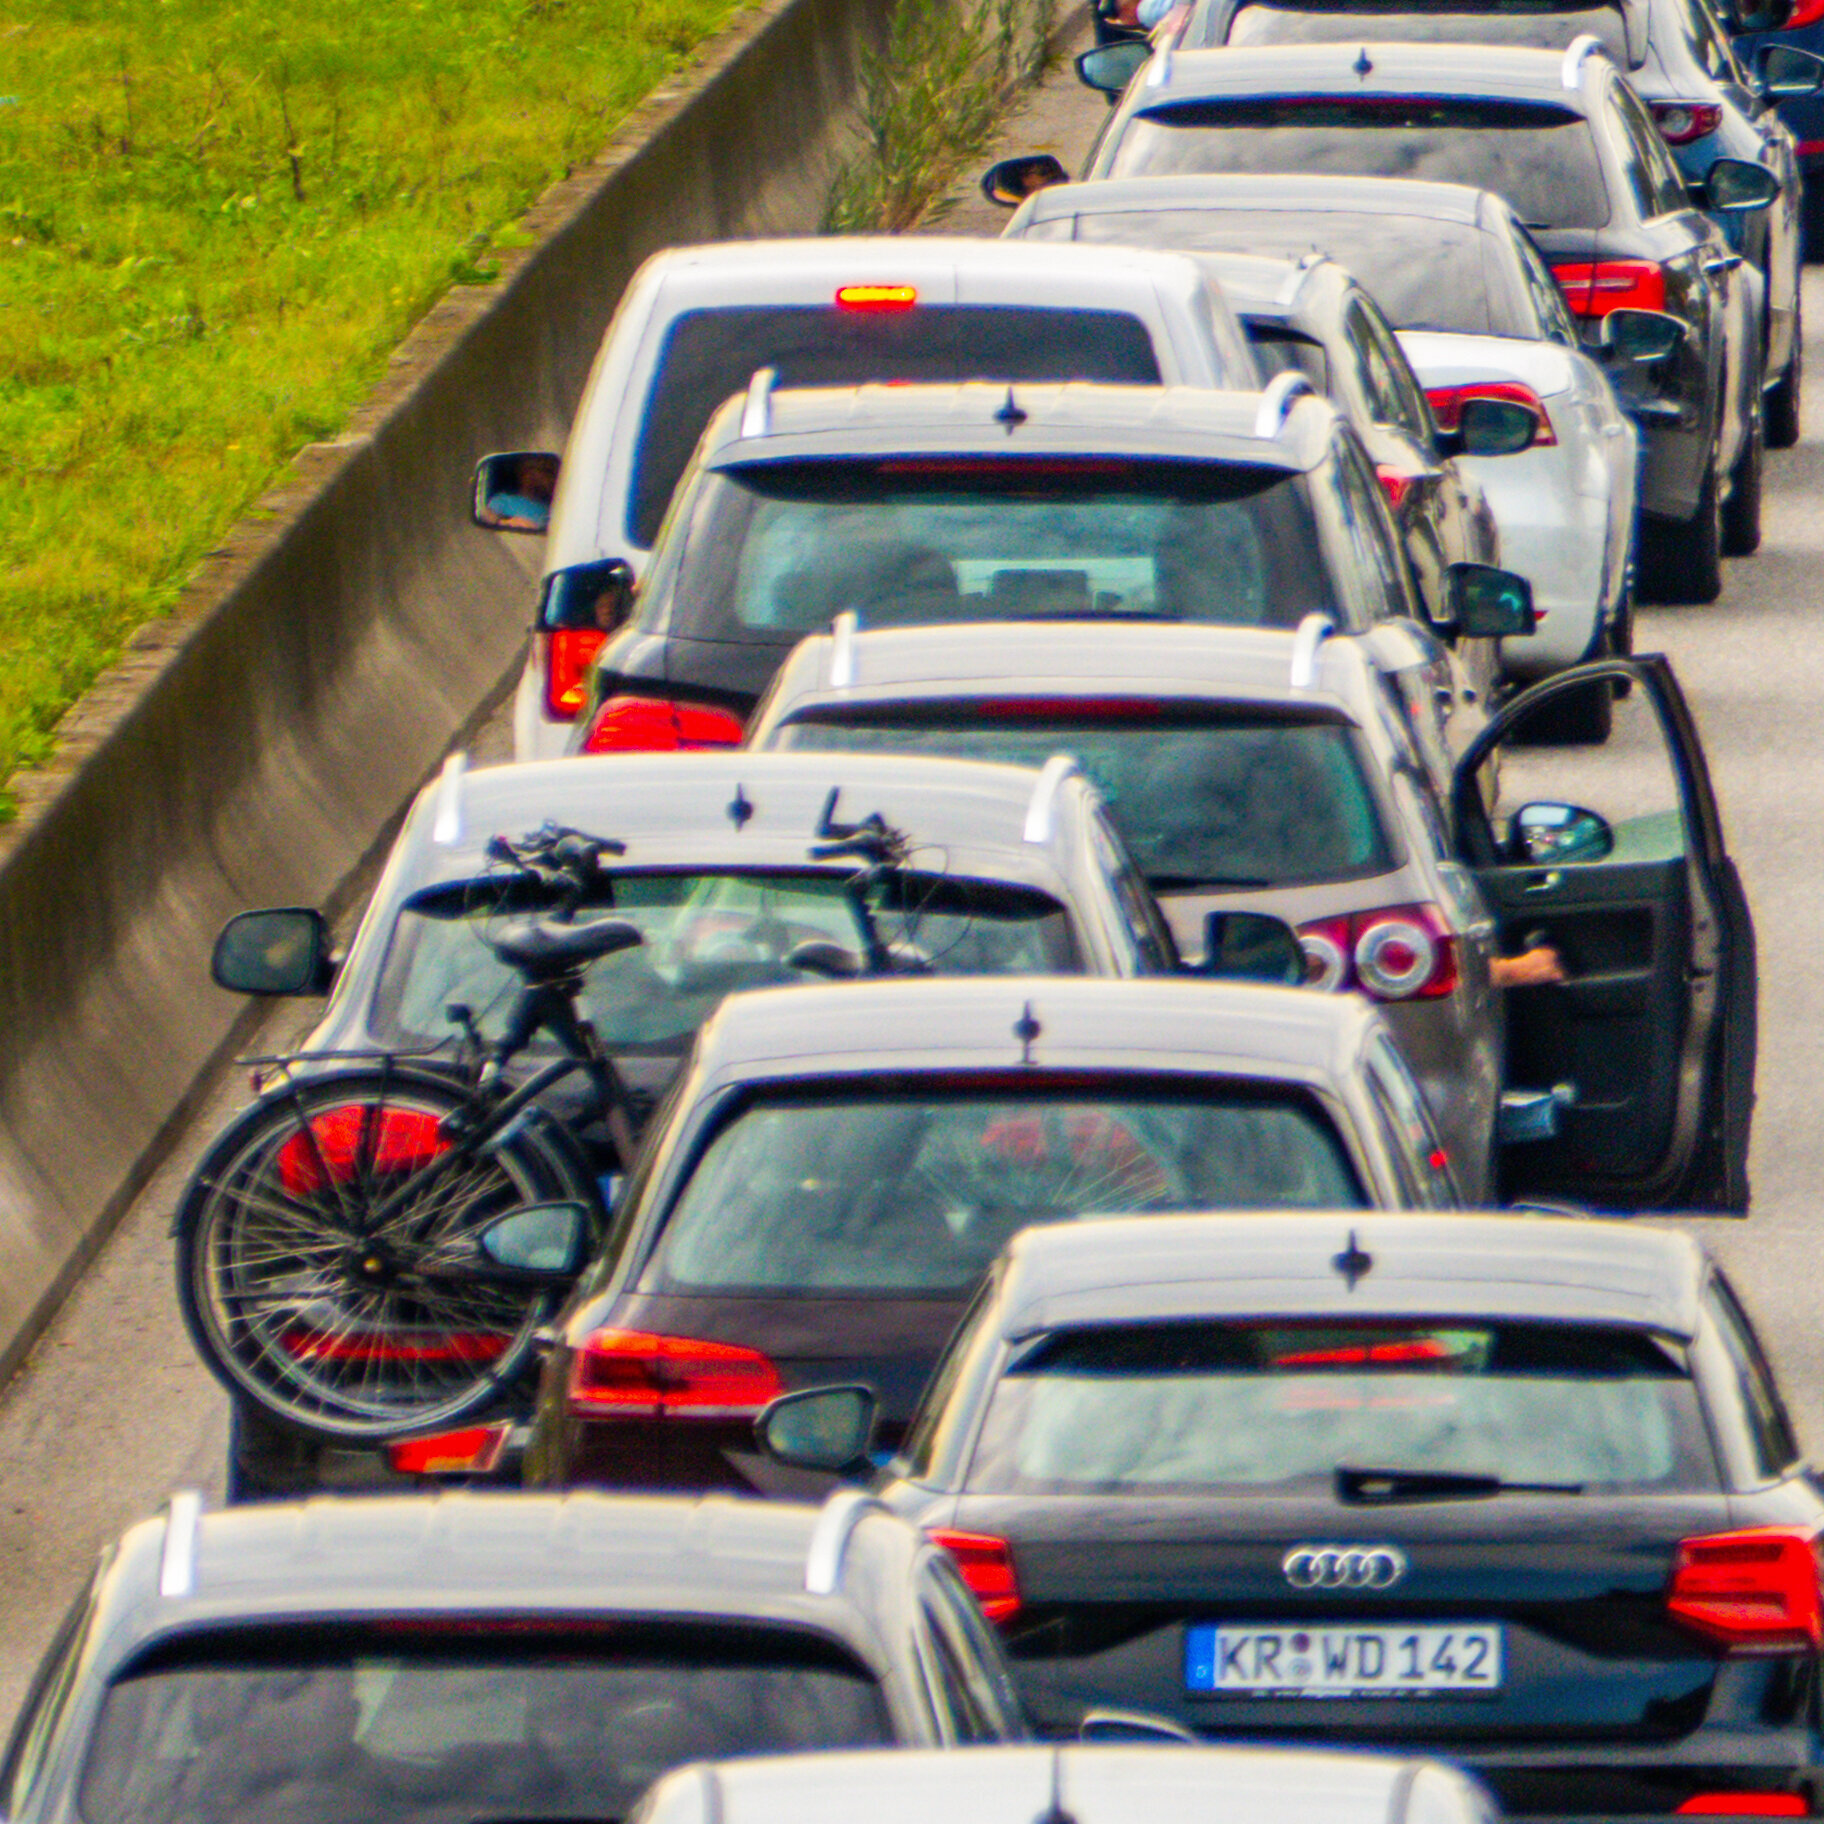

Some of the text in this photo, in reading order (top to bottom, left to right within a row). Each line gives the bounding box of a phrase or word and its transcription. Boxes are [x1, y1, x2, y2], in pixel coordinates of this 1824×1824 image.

[1219, 1634, 1489, 1680] KR WD 142
